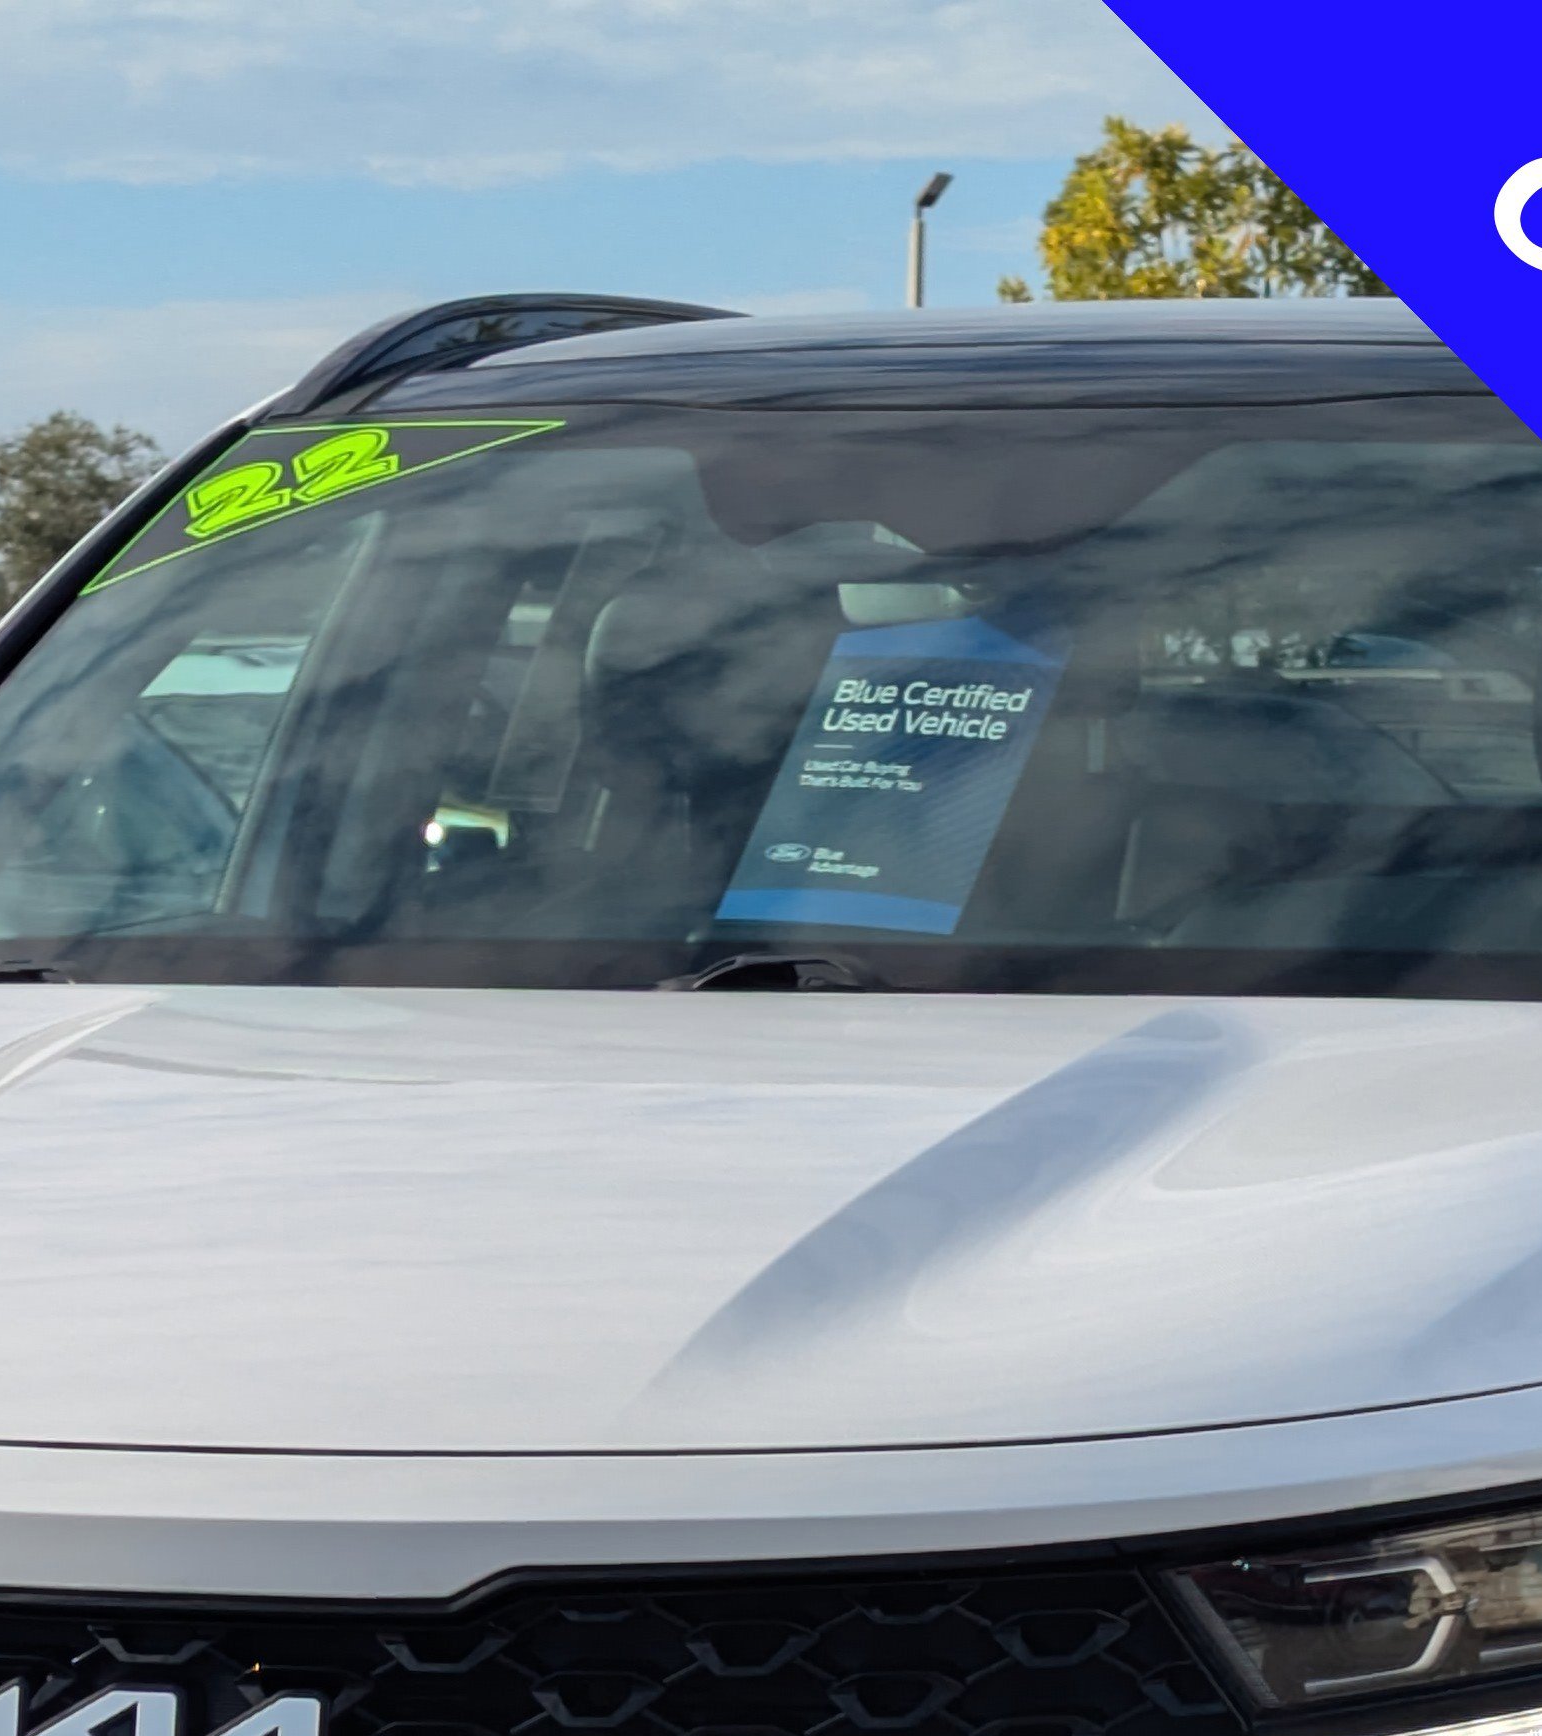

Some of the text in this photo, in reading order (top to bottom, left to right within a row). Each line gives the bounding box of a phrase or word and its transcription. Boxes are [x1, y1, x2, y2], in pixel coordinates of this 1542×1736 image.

[184, 428, 400, 539] 22
[832, 679, 1033, 712] Blue Certified
[822, 708, 1007, 740] Used Vehicle
